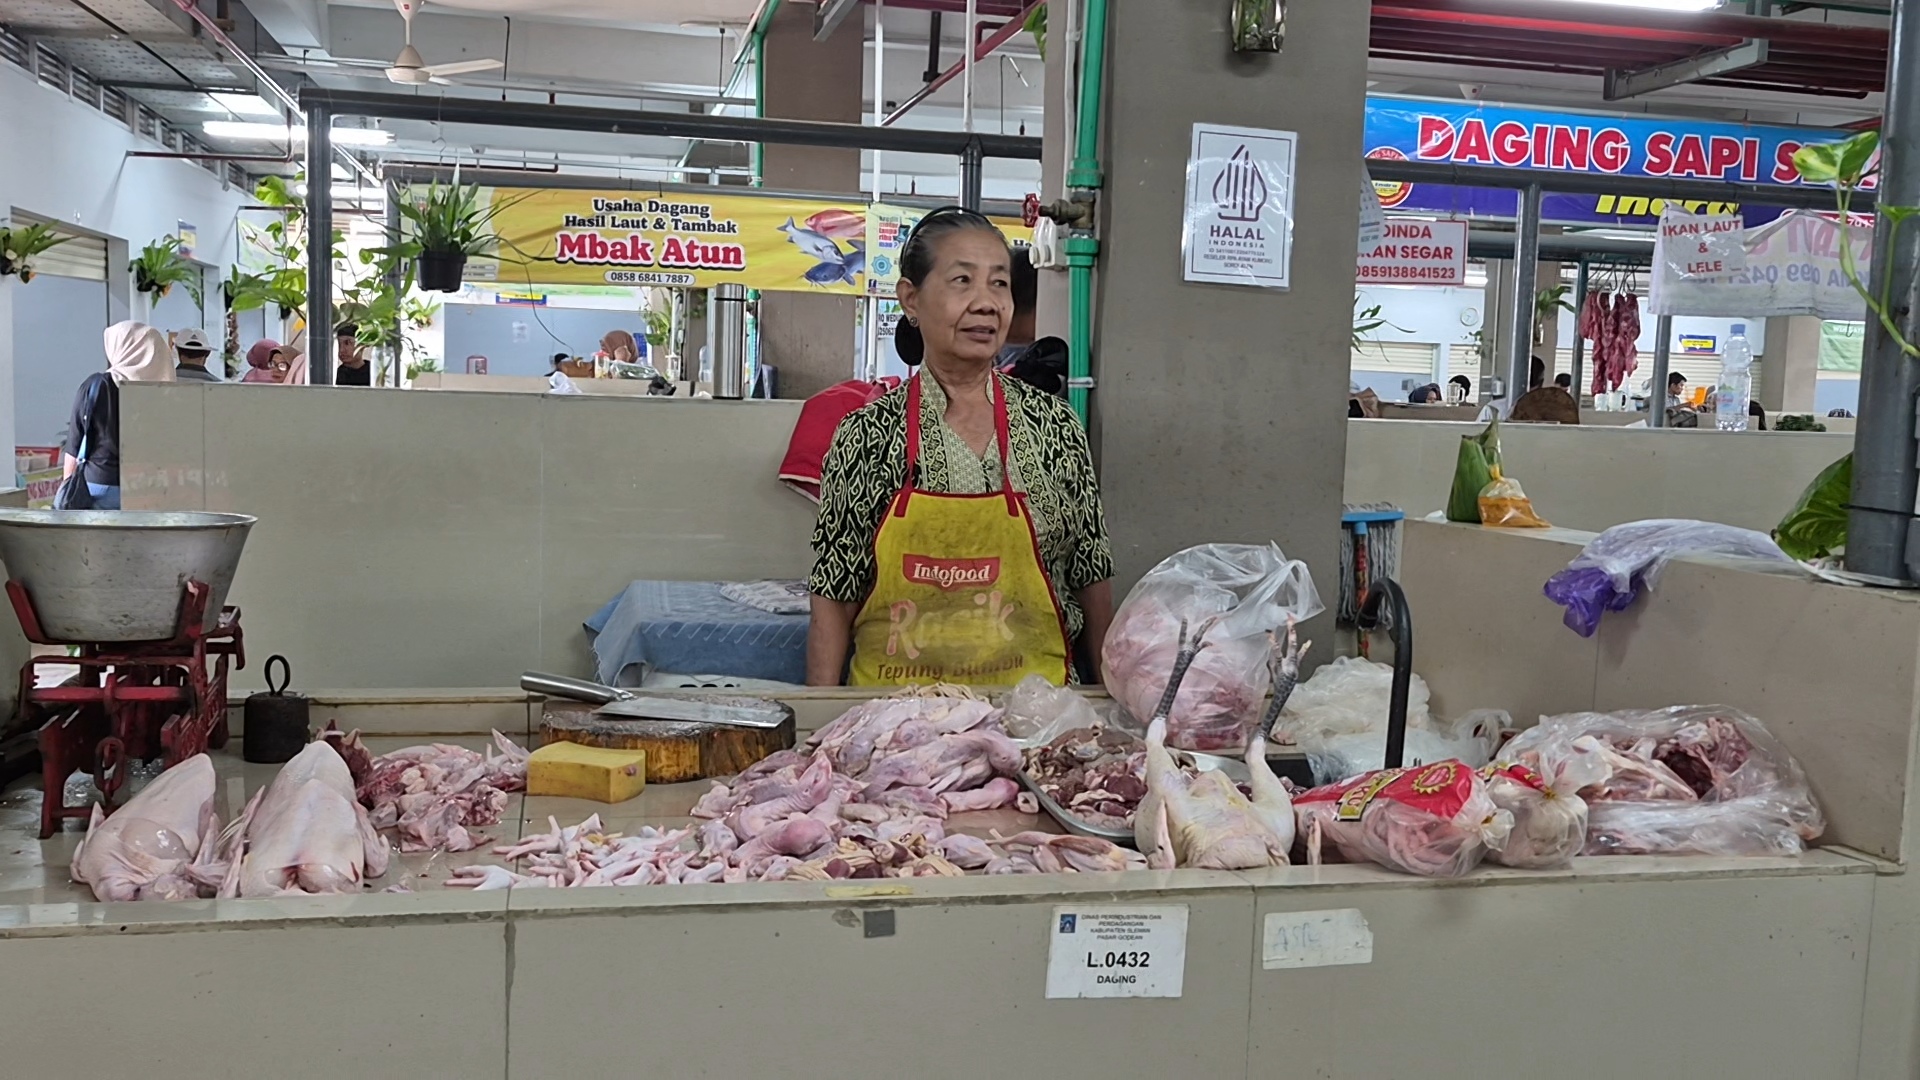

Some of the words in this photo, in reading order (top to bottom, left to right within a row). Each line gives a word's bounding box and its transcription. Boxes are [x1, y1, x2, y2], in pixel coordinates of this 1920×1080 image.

[1418, 116, 1630, 174] DAGING
[1643, 131, 1760, 180] SAPI
[593, 199, 643, 213] Usaha
[648, 200, 710, 218] Dagang
[565, 215, 605, 228] Hasil
[611, 216, 648, 229] Laut
[653, 218, 666, 230] &
[671, 218, 737, 233] Tambak
[1210, 225, 1265, 240] HALAL
[1663, 223, 1699, 237] IKAN
[1704, 220, 1741, 233] LAUT
[557, 232, 652, 263] Mbak
[662, 237, 743, 266] Atun
[1209, 240, 1264, 248] INDONESIA
[1698, 242, 1708, 254] &
[1401, 246, 1453, 260] SEGAR
[1688, 260, 1722, 274] LELE
[611, 272, 636, 282] 0858
[638, 272, 663, 283] 6841
[665, 273, 690, 284] 7887
[912, 563, 991, 587] Indofood
[877, 663, 944, 681] Tepung
[1087, 951, 1150, 968] L.0432
[1096, 975, 1137, 984] DAGING
